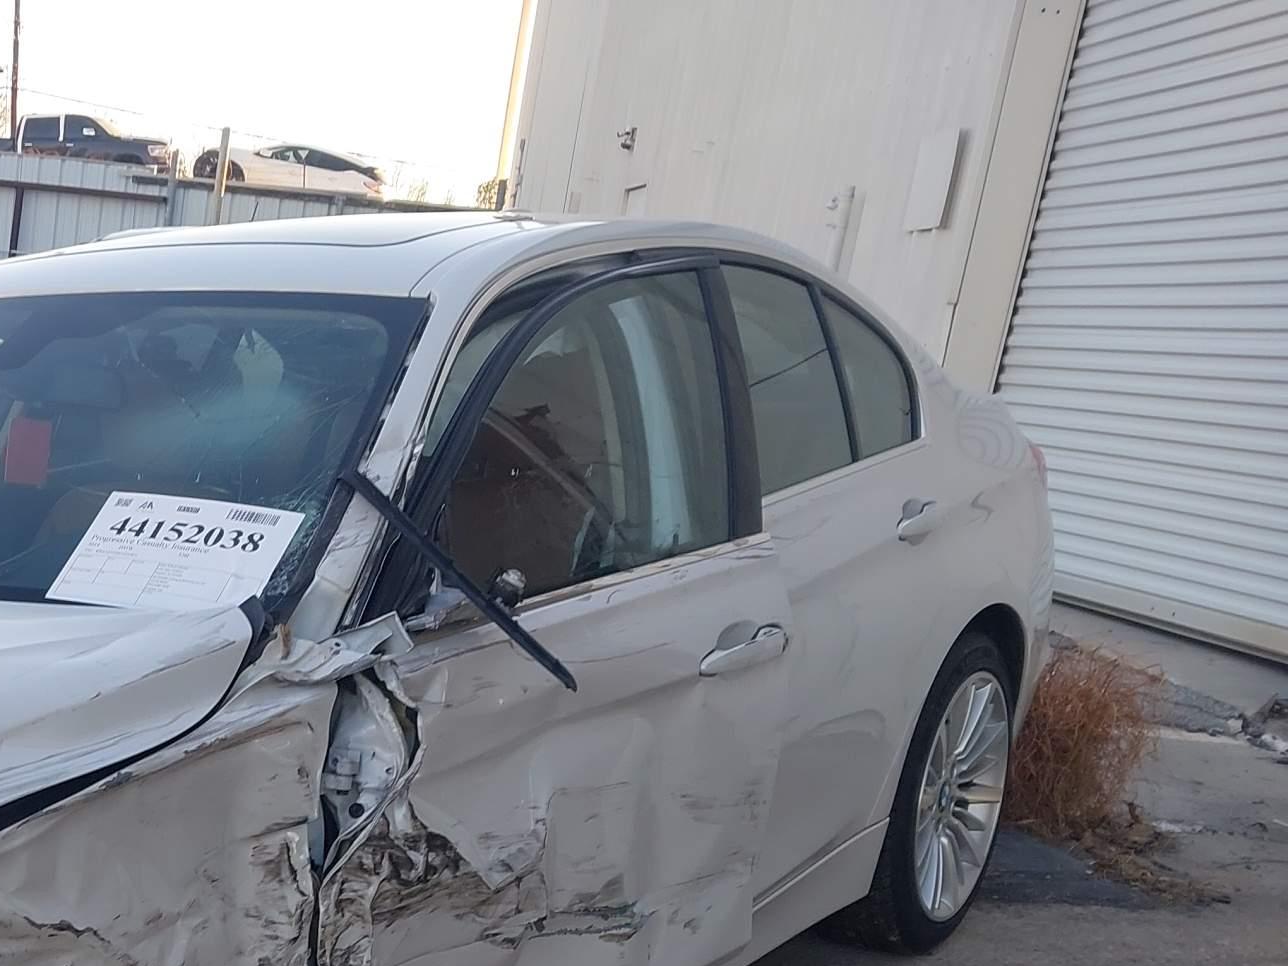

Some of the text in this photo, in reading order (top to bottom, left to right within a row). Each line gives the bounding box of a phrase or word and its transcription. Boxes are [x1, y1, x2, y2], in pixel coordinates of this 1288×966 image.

[91, 534, 134, 545] Progressive
[136, 538, 169, 549] Casualty
[171, 542, 210, 554] Insurance
[109, 516, 265, 552] 44152038
